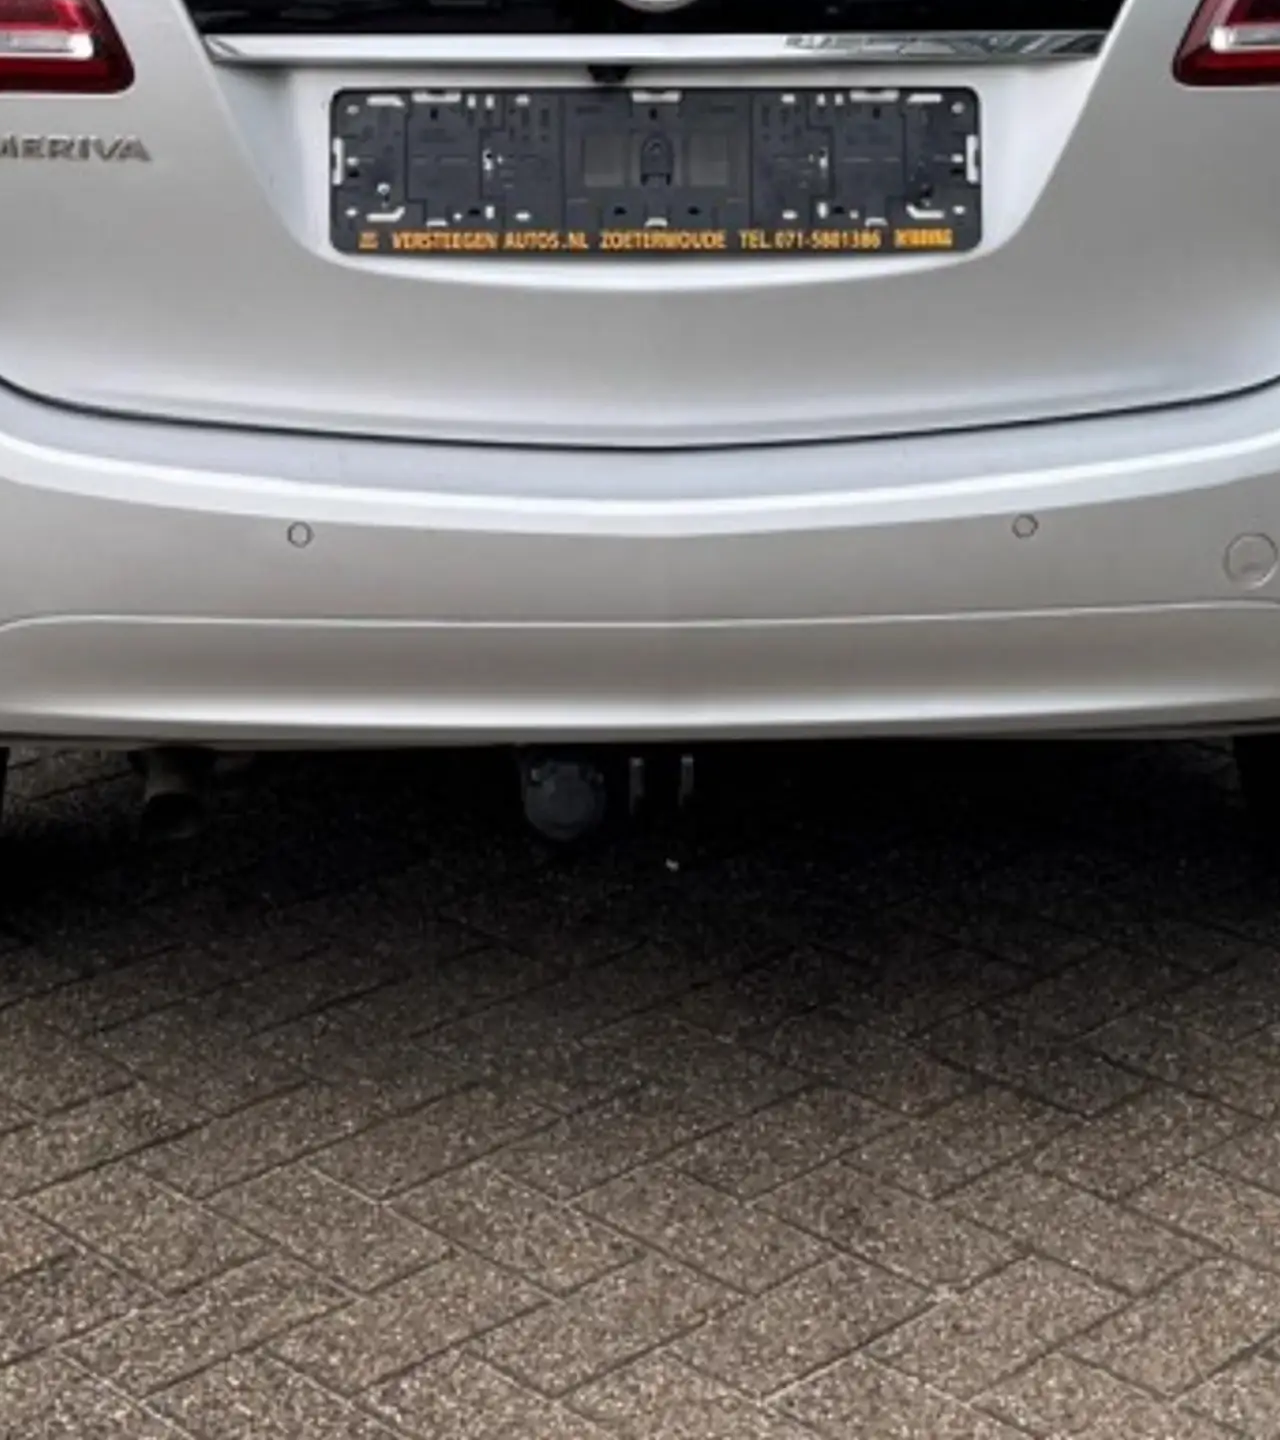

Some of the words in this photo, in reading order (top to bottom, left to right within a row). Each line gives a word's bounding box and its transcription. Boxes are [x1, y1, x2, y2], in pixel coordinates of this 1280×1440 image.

[391, 231, 499, 250] VERSTEEGEN
[503, 231, 589, 250] AUTOS.NL
[600, 230, 727, 250] ZOETERWOUDE
